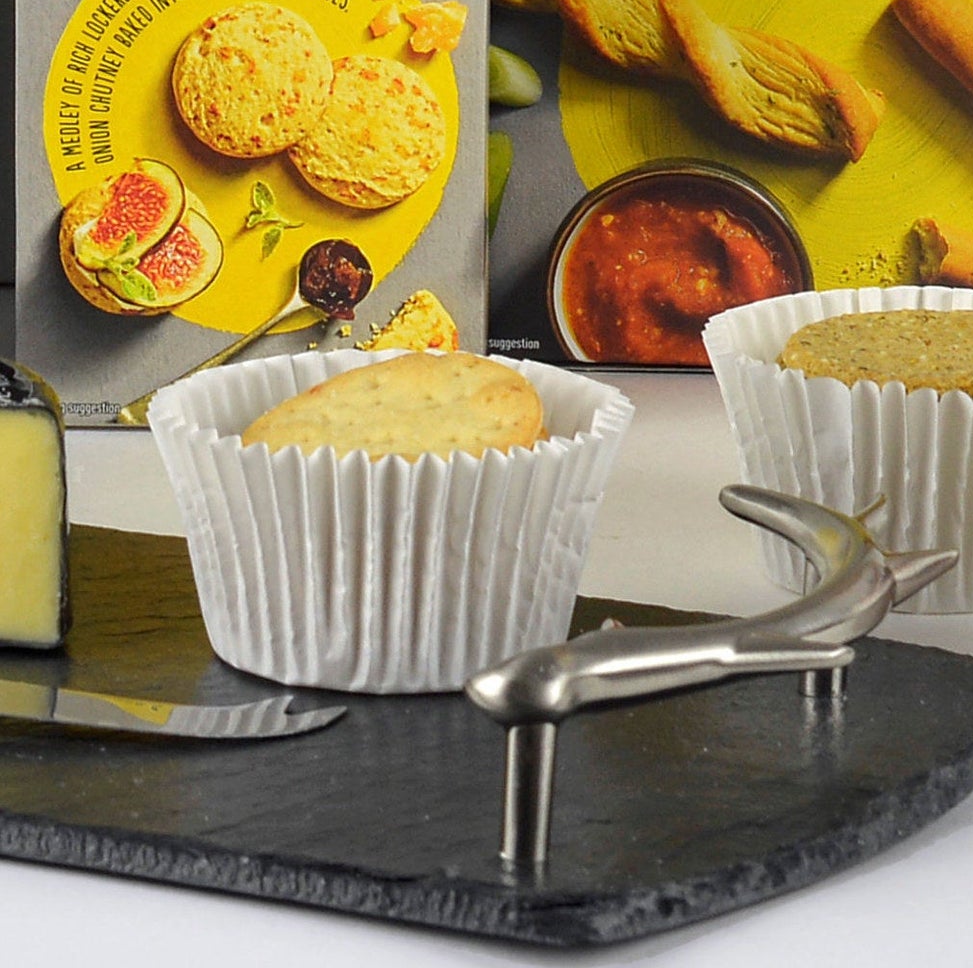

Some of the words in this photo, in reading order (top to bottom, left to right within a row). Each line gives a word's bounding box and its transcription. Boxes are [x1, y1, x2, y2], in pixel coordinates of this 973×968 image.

[114, 6, 153, 48] BAKED
[66, 40, 96, 74] RICH
[61, 77, 84, 96] OF
[90, 47, 125, 113] CHUTNEY
[60, 101, 82, 157] MEDLEY
[90, 120, 114, 165] ONION
[66, 160, 87, 173] A
[487, 338, 541, 352] suggestion
[67, 402, 121, 417] suggestion
